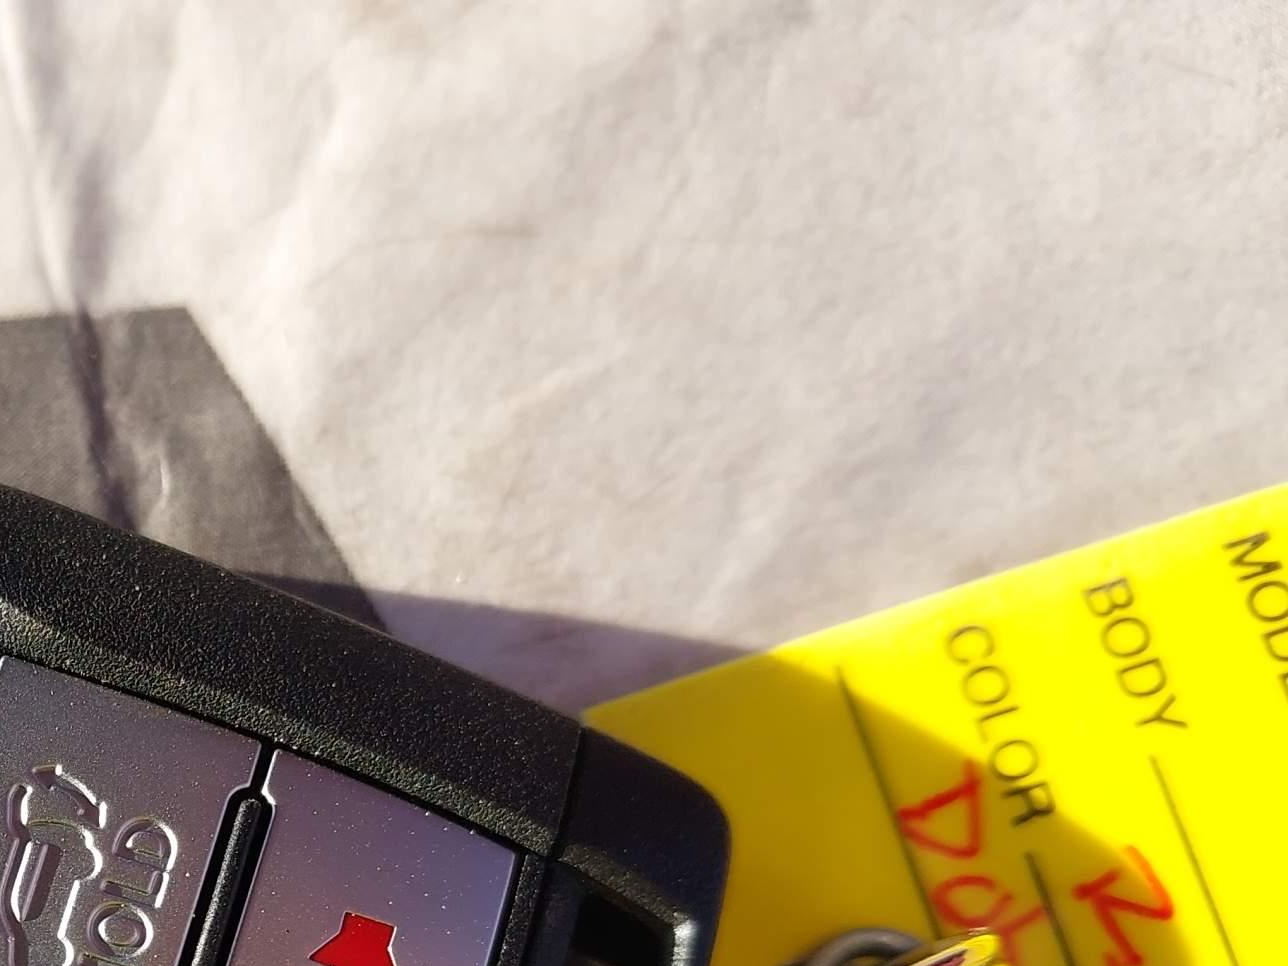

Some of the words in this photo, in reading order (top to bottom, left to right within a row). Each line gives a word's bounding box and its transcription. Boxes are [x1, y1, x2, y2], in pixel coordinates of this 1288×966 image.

[1082, 576, 1189, 730] BODY
[1221, 530, 1288, 705] MOD
[944, 624, 1057, 828] COLOR
